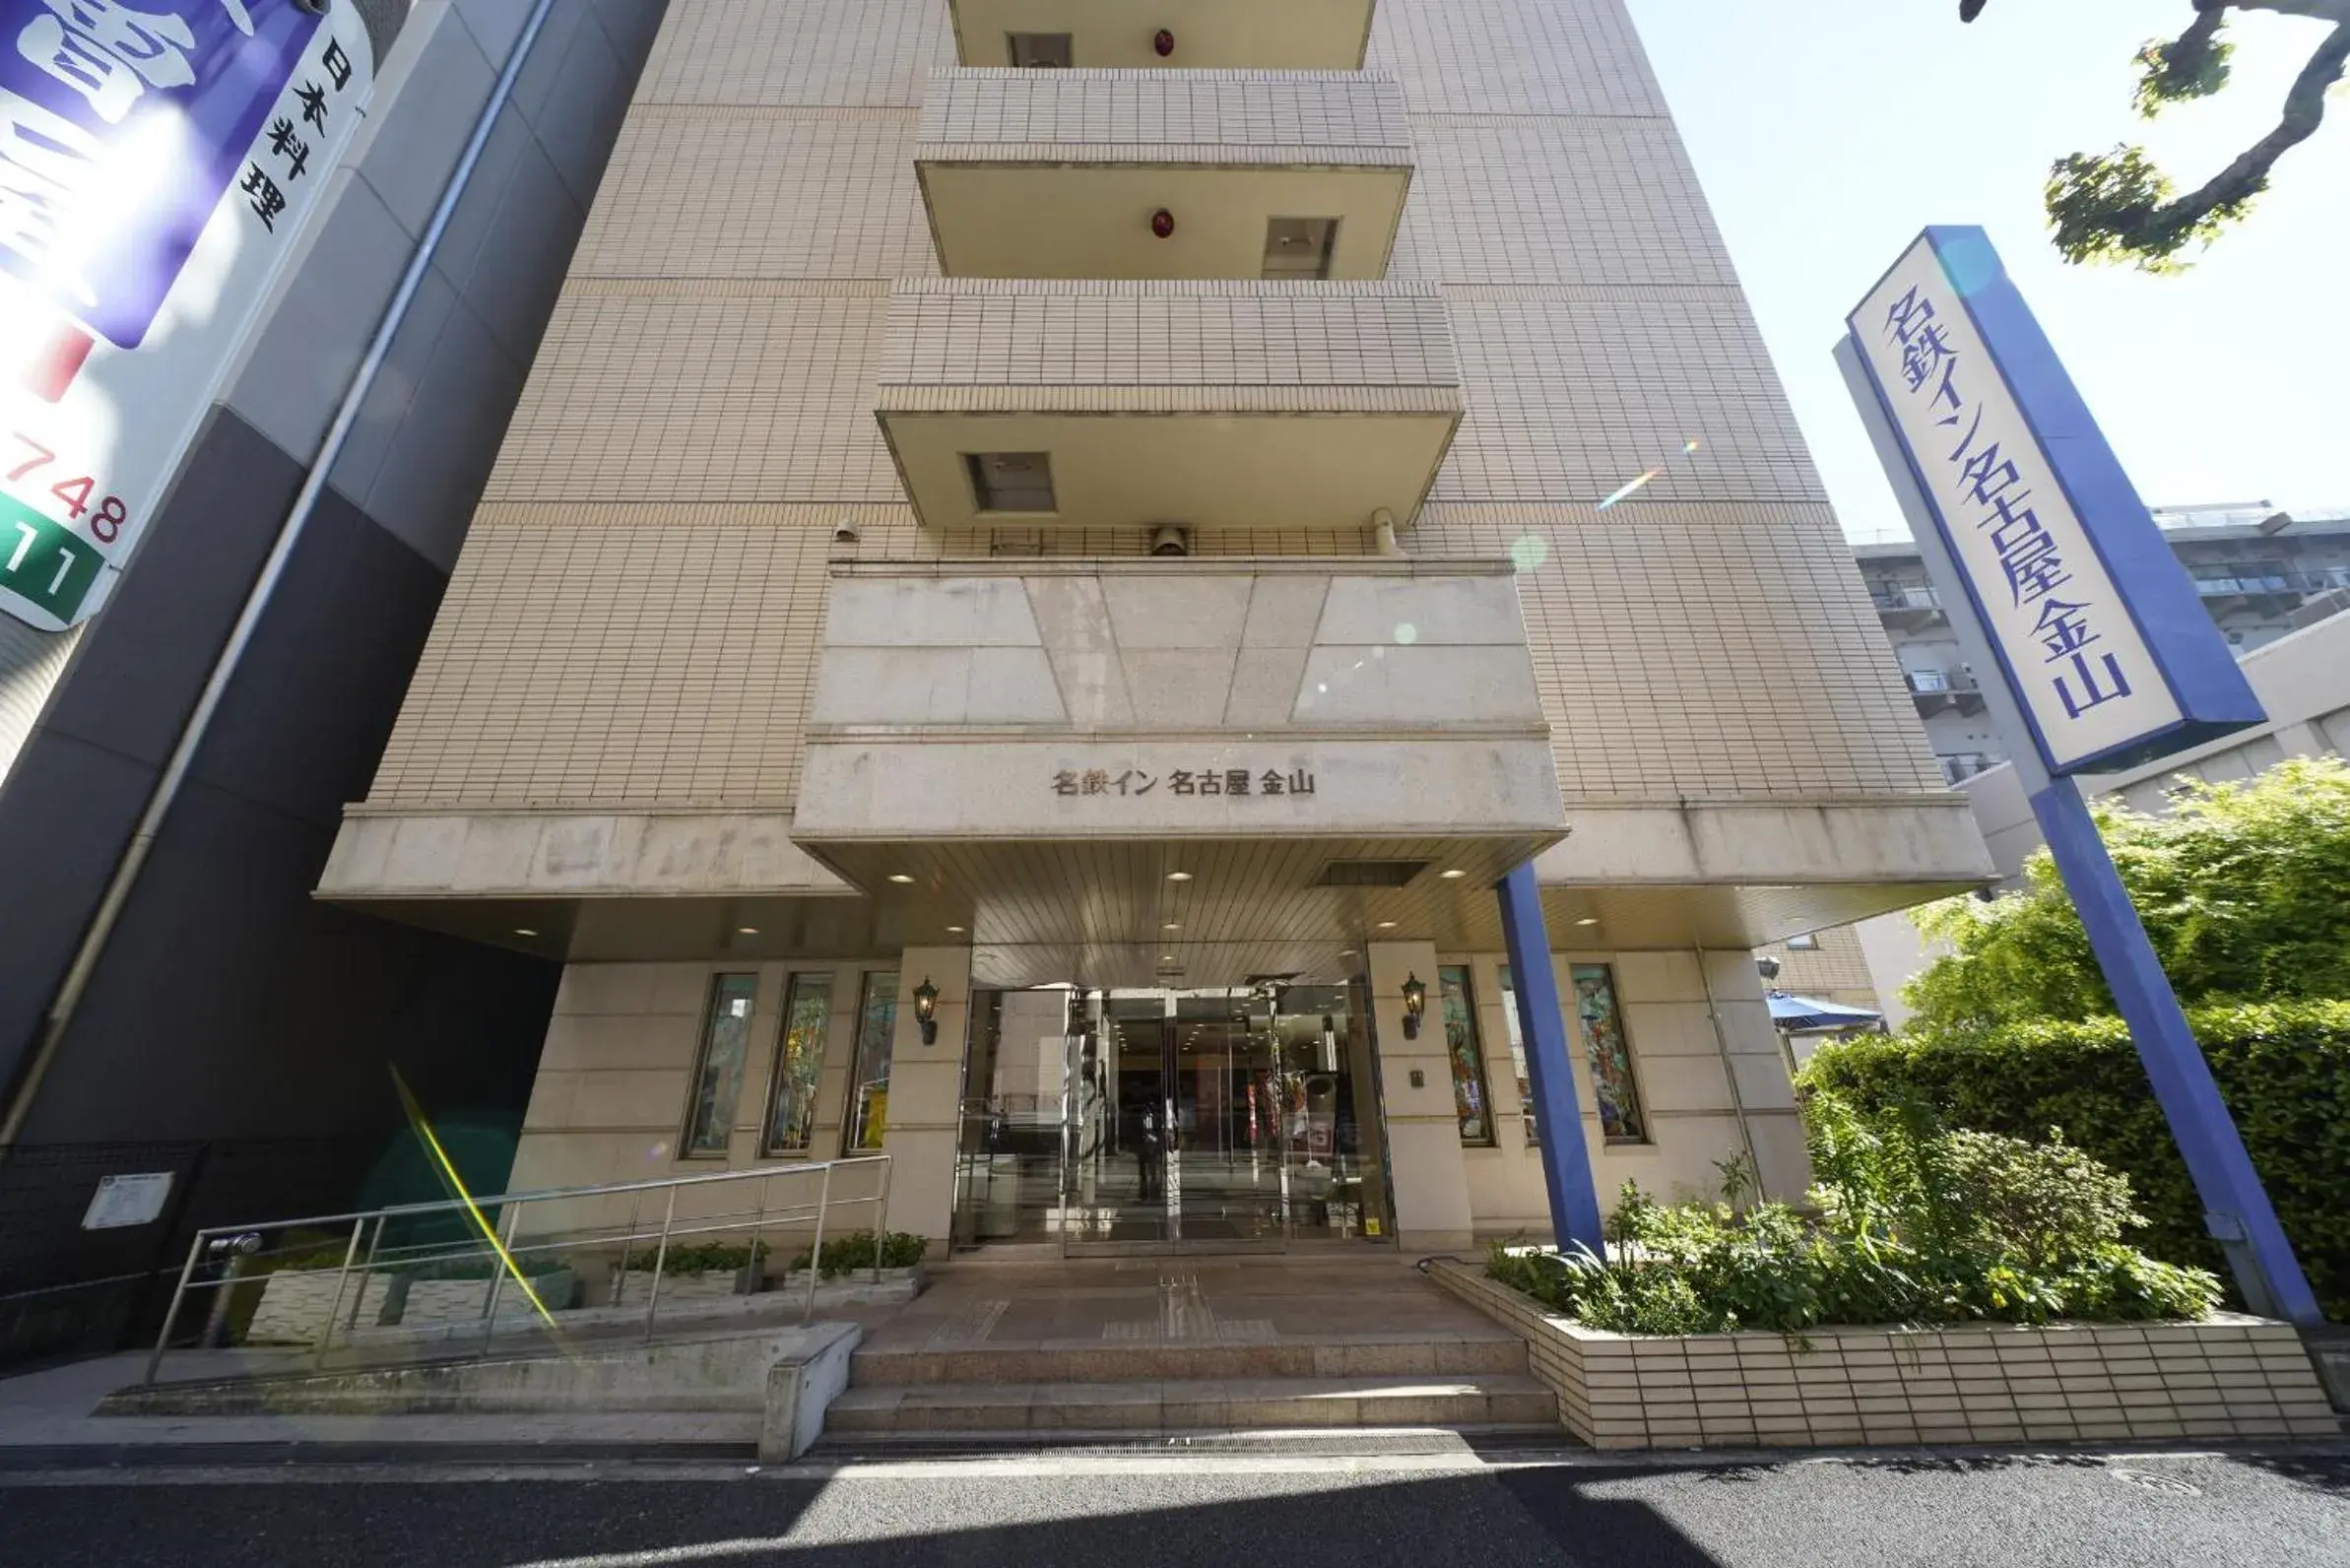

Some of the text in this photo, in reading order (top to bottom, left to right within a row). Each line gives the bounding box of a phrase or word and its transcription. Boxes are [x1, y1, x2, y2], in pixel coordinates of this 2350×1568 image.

[239, 34, 352, 235] 日本料理
[1882, 283, 2132, 720] 名鉄イン名古屋金山
[1167, 768, 1251, 796] 名古屋
[1259, 767, 1316, 796] 金山
